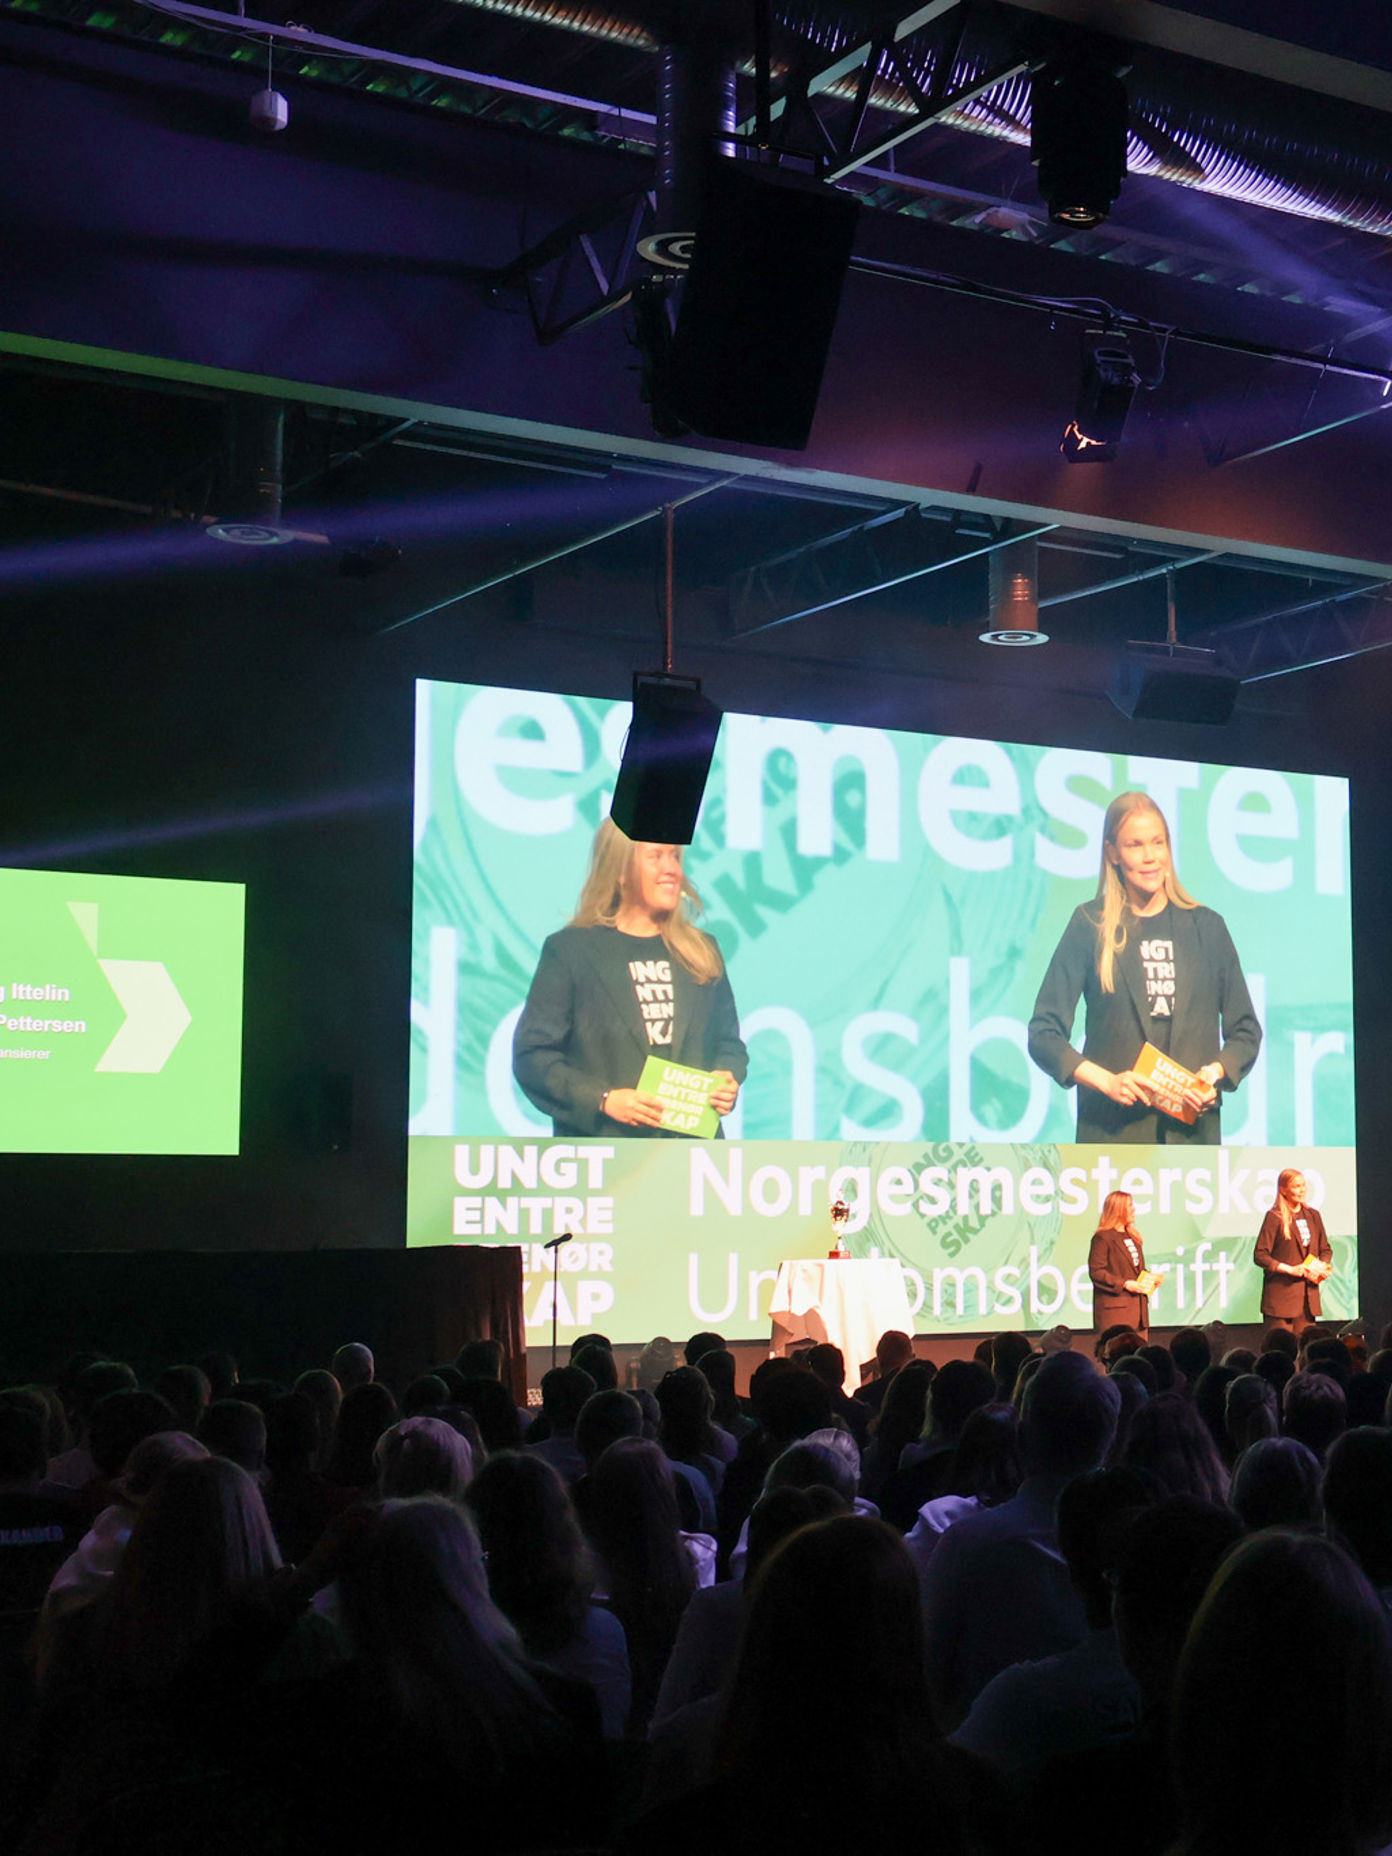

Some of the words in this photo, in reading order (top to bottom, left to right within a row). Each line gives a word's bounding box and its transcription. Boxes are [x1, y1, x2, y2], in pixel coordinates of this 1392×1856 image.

[11, 982, 70, 1001] Ittelin
[662, 1066, 713, 1090] UNGT
[1155, 1057, 1196, 1087] UNGT
[657, 1082, 708, 1105] ENTRE
[453, 1144, 616, 1189] UNGT
[452, 1196, 615, 1235] ENTRE
